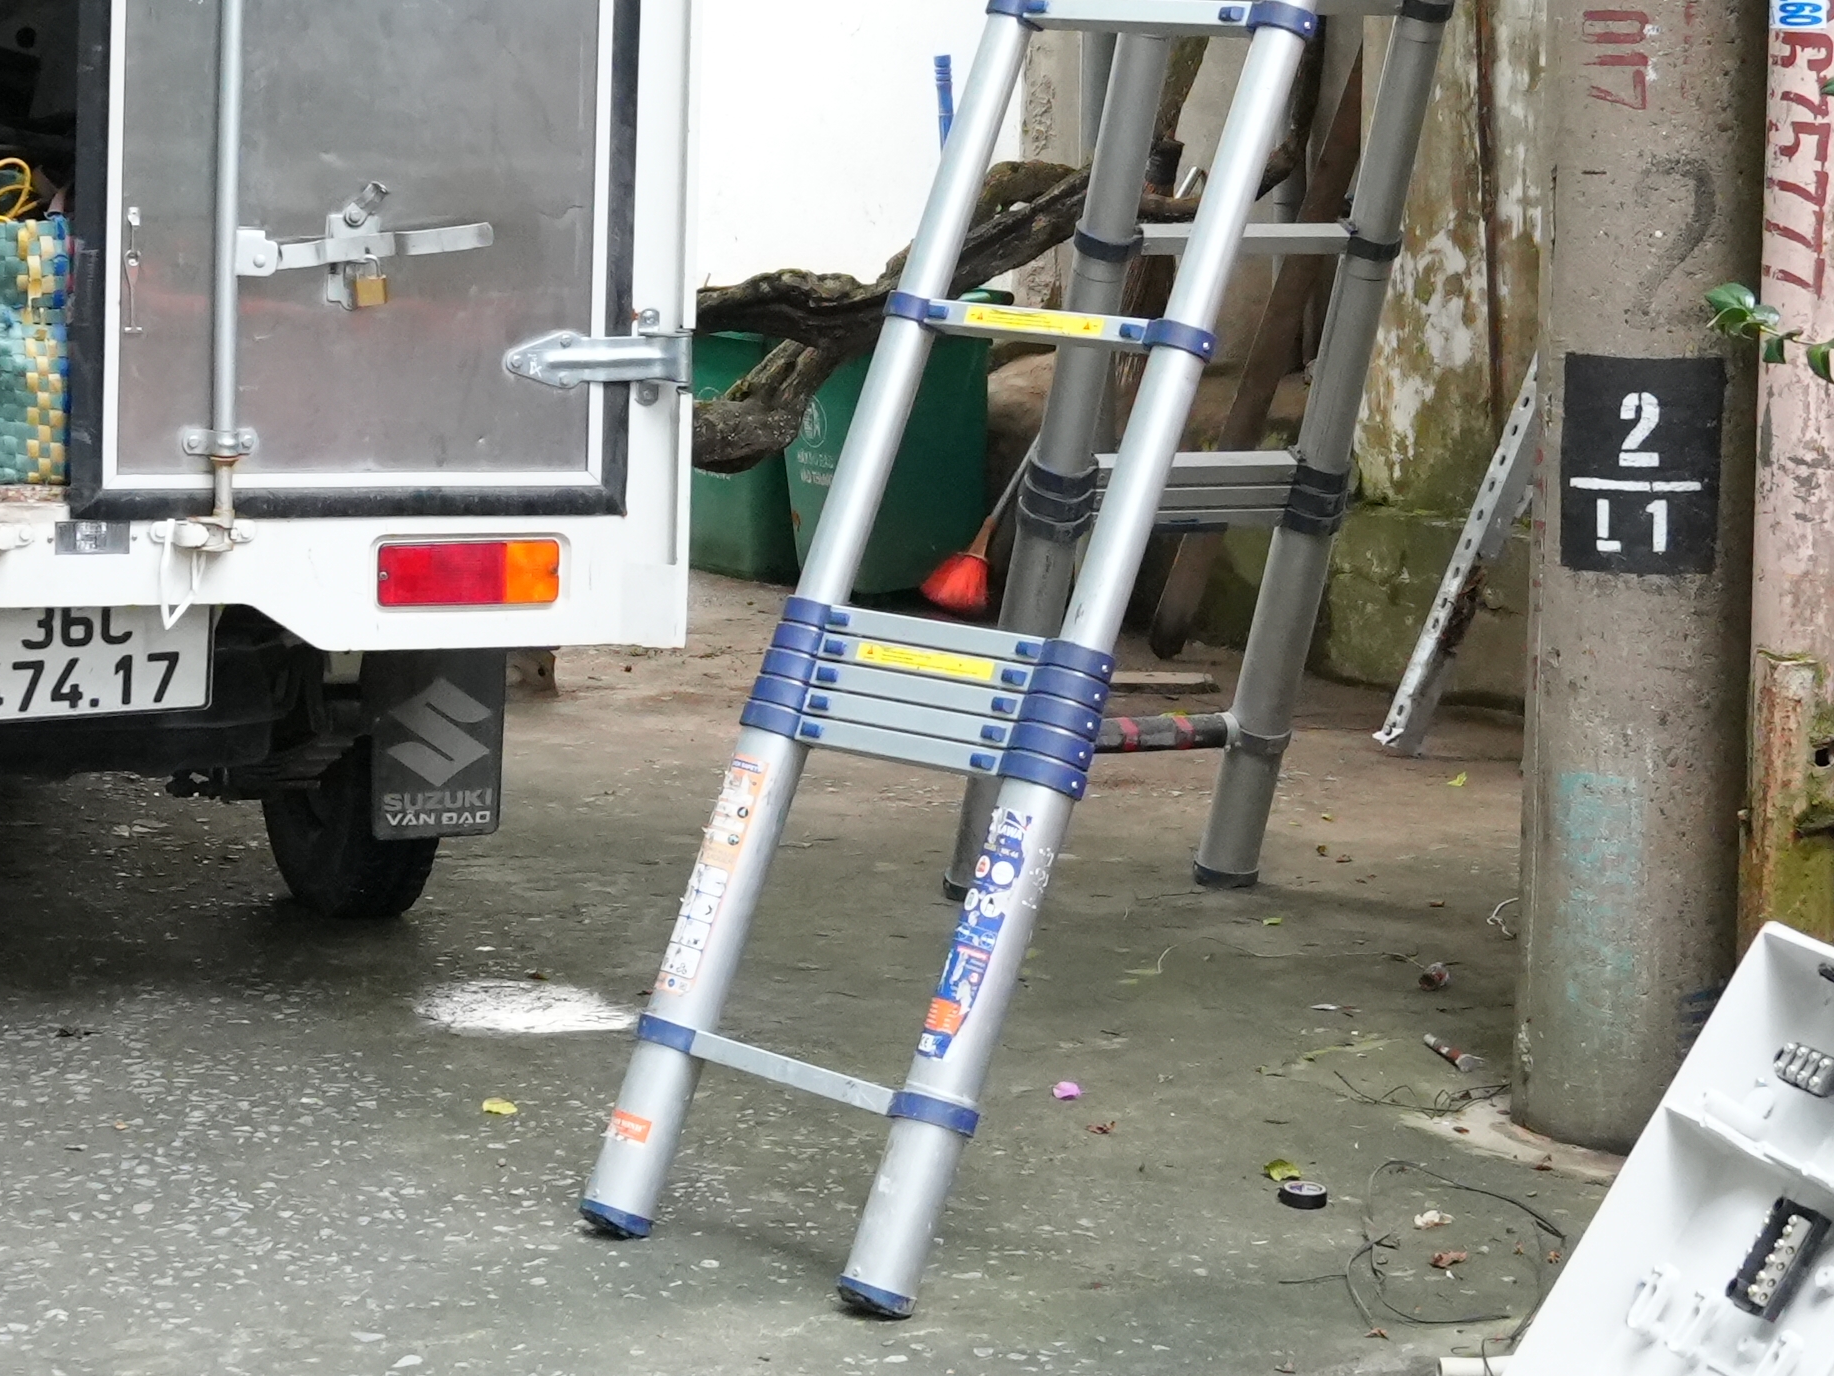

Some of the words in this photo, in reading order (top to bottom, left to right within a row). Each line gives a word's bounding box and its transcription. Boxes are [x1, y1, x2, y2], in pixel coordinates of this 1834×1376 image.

[1619, 392, 1660, 468] 2
[384, 788, 493, 811] SUZUKI
[385, 810, 436, 826] VÂN
[441, 810, 491, 827] ĐẠO
